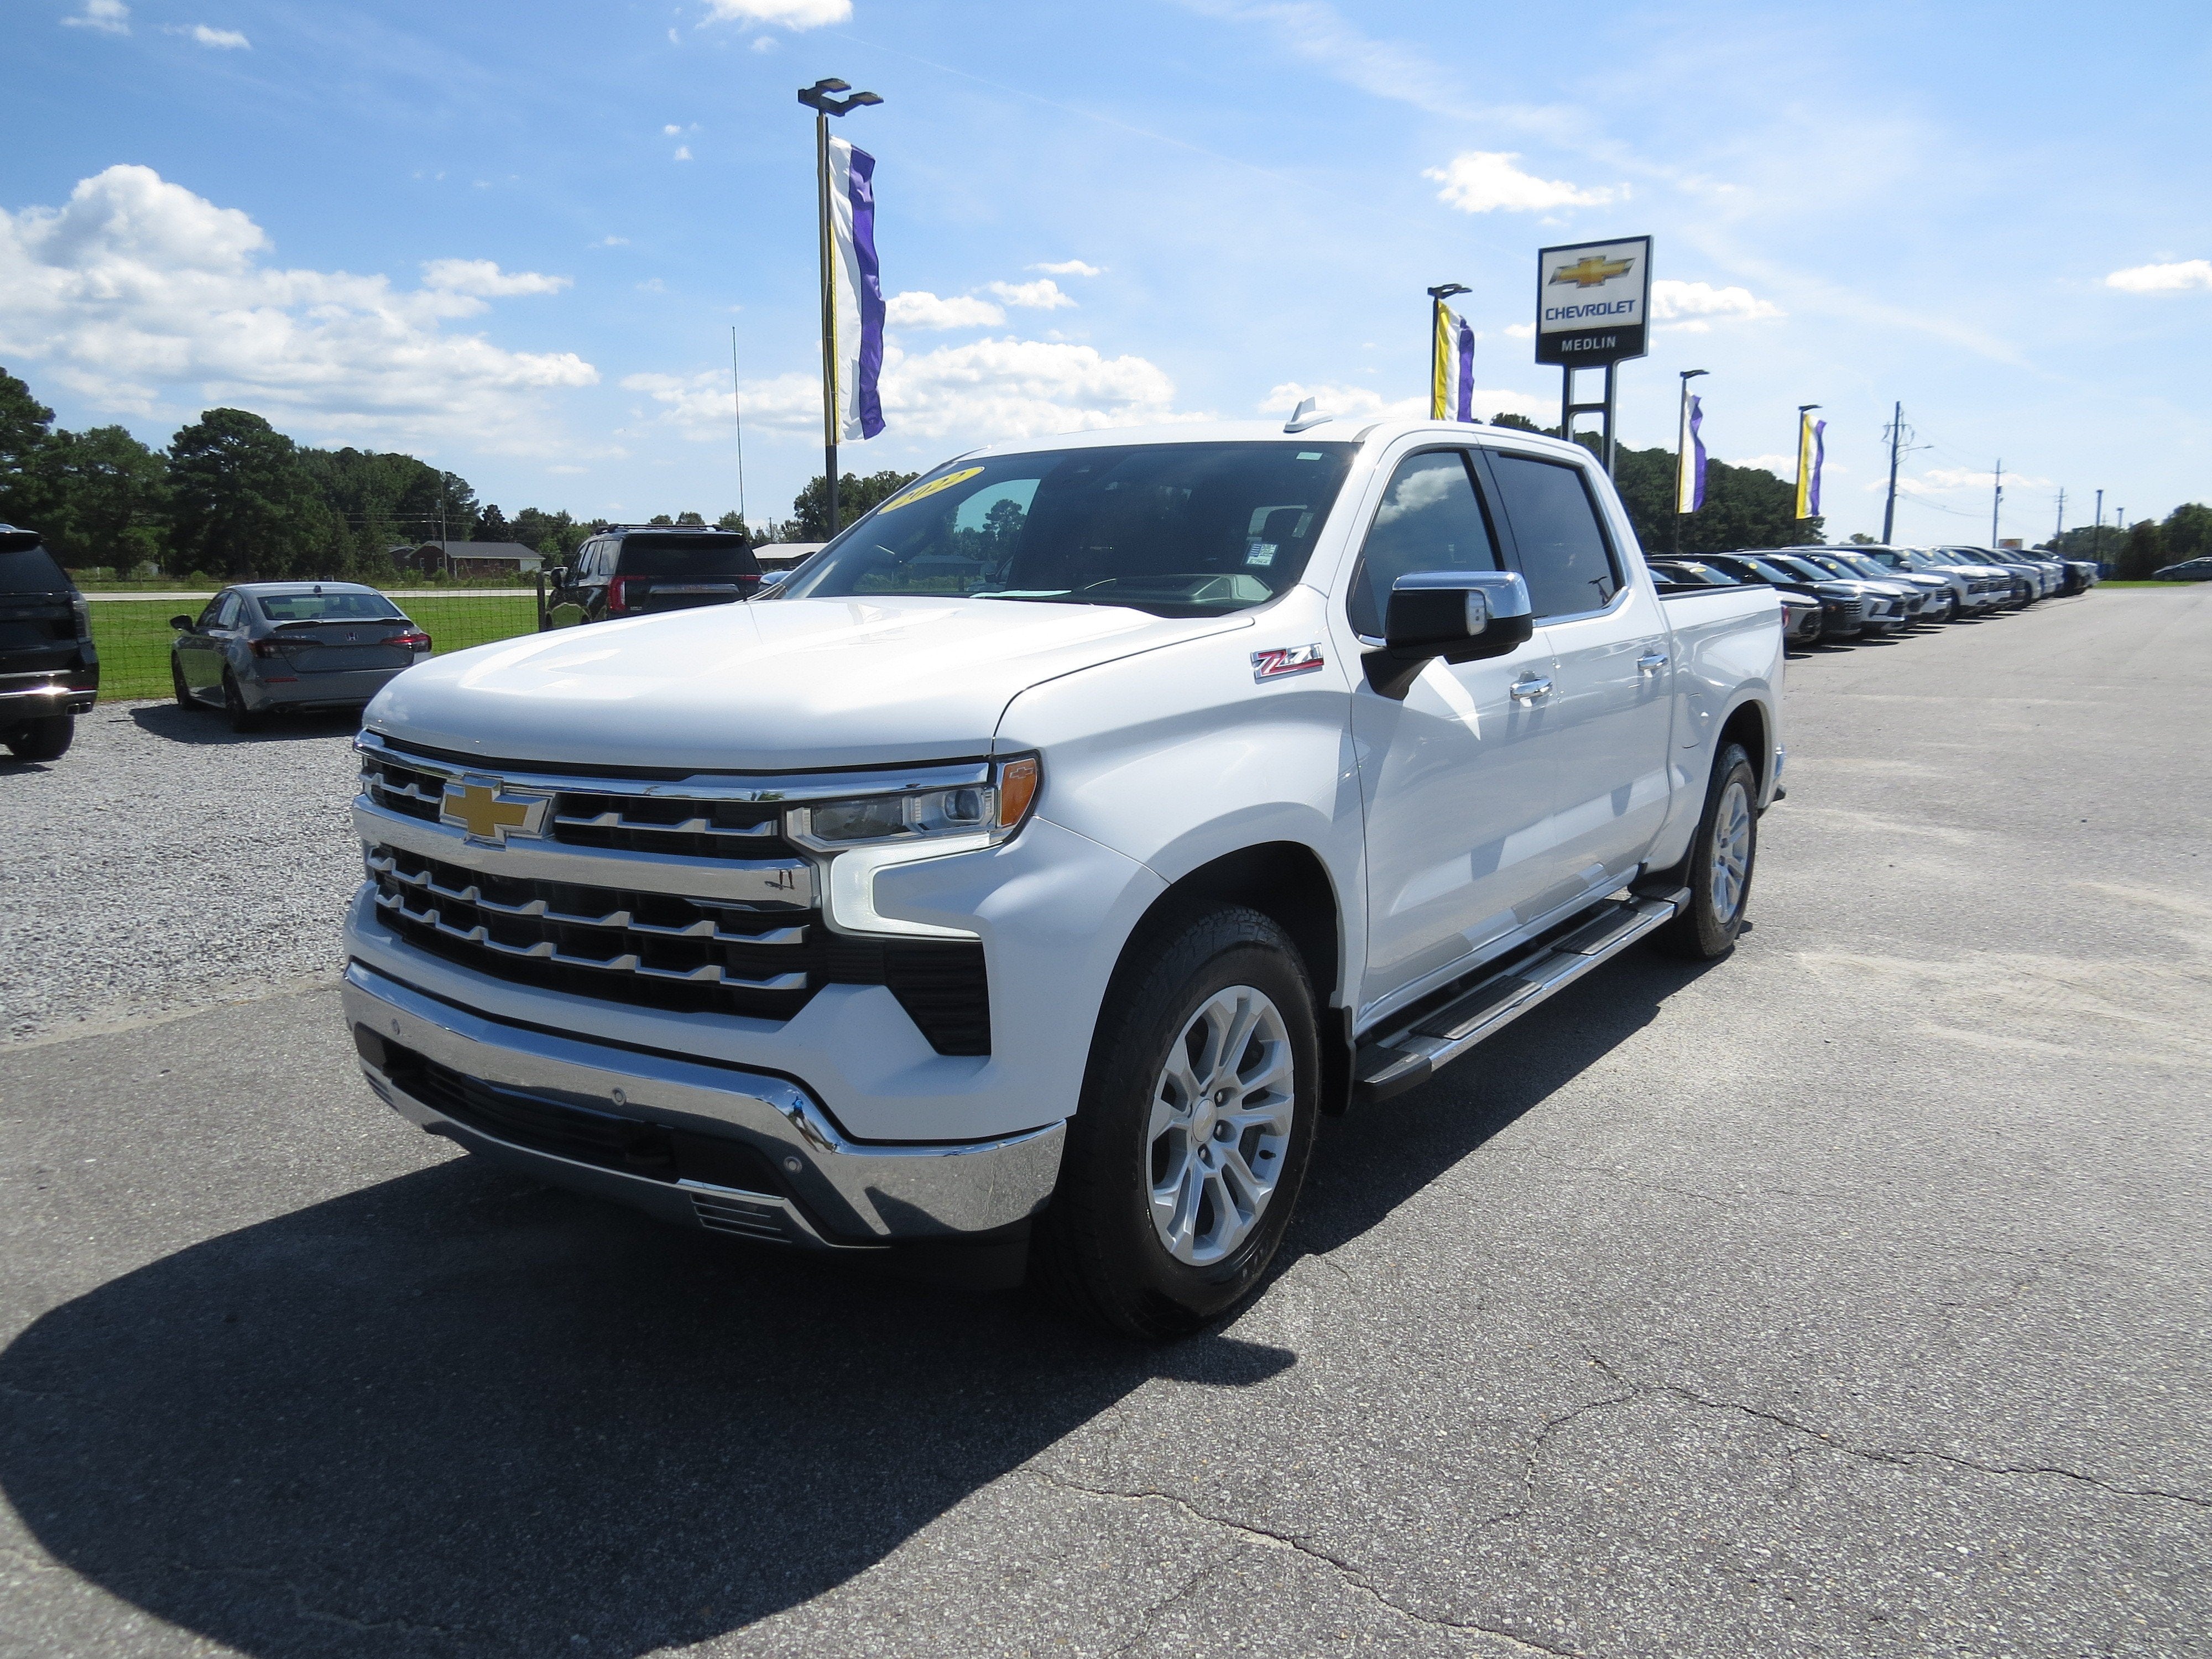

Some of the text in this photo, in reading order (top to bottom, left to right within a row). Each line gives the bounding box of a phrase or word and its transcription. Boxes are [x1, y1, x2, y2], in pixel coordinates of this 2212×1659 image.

[1546, 300, 1635, 320] CHEVROLET
[1562, 336, 1616, 352] MEDLIN
[1254, 643, 1324, 676] Z71
